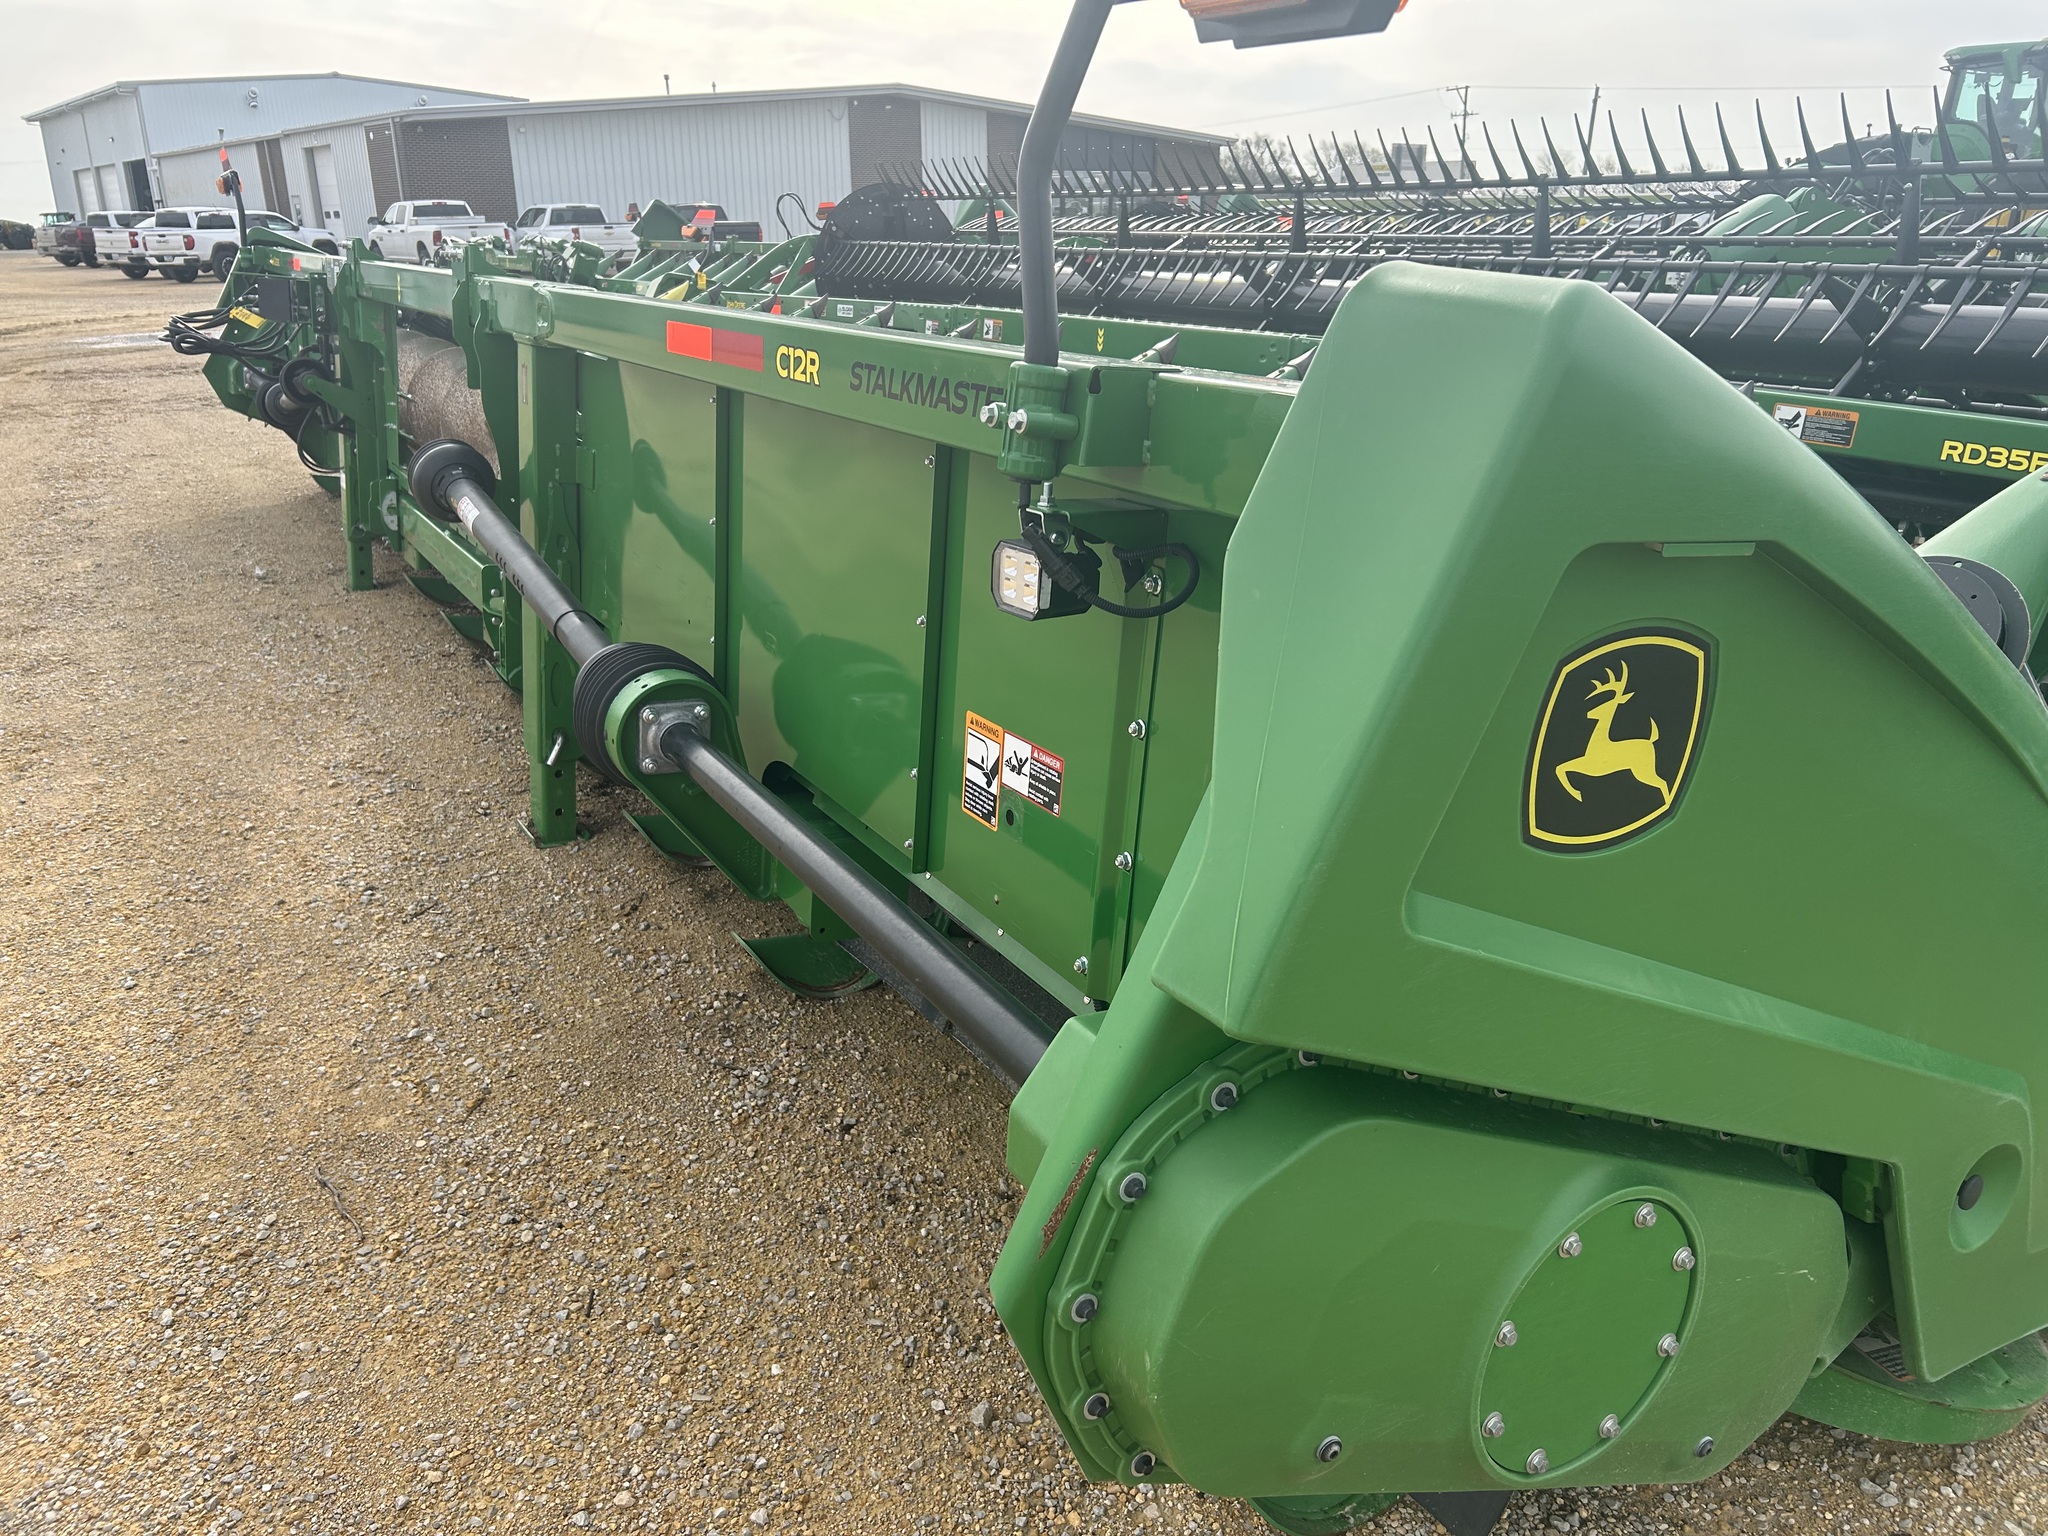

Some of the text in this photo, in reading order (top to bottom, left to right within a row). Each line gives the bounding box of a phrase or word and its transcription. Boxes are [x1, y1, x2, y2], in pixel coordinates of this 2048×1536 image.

[776, 344, 821, 387] C12R
[849, 361, 1006, 418] STALKMASTE
[1822, 410, 1851, 420] WARNING
[974, 718, 1000, 739] WARNING
[1038, 752, 1061, 770] DANGER
